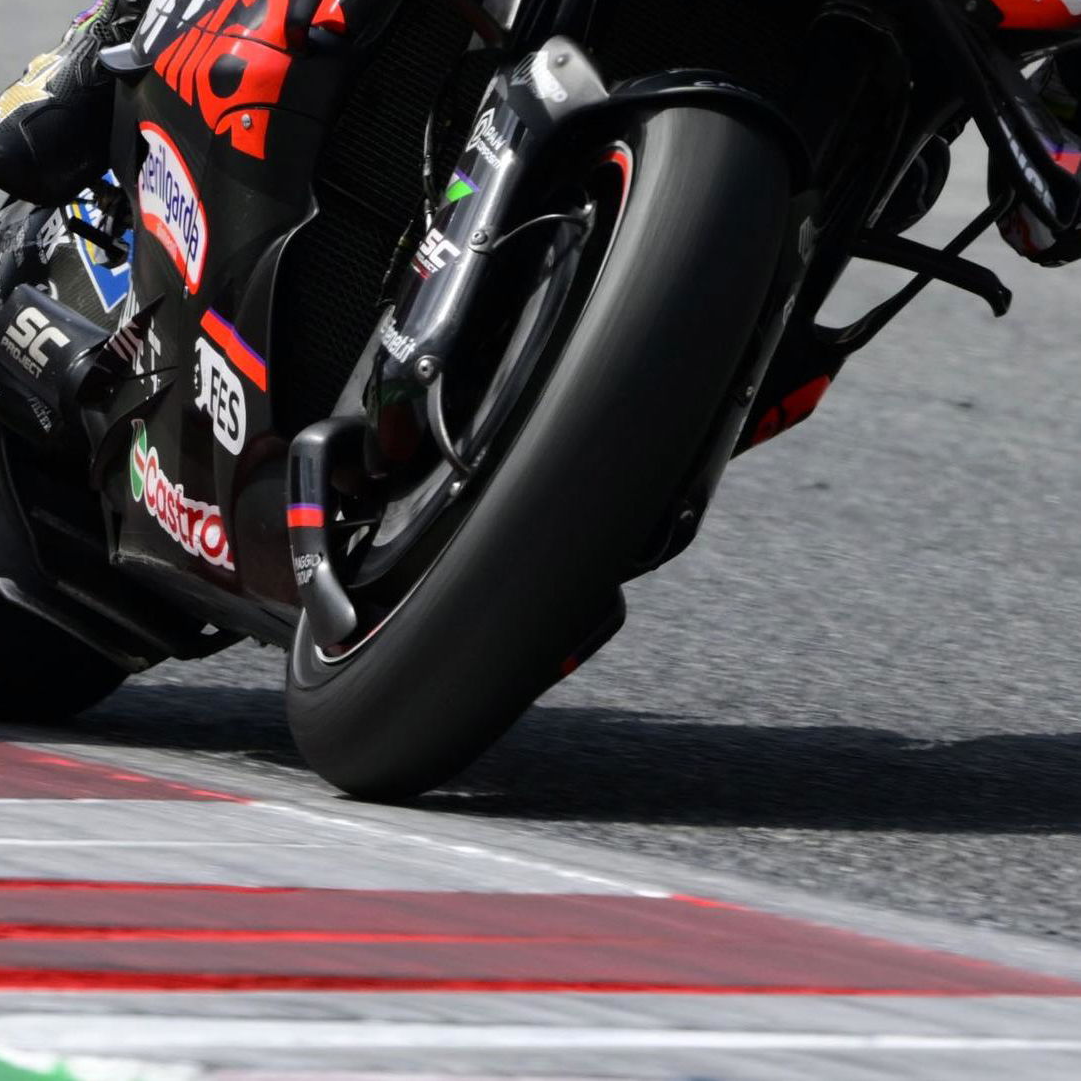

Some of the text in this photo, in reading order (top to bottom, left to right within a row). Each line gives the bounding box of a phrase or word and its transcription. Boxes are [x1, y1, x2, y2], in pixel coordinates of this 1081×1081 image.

[419, 228, 462, 269] SC
[1, 335, 43, 379] PROJECT
[6, 306, 71, 368] SC
[145, 454, 234, 563] Castro
